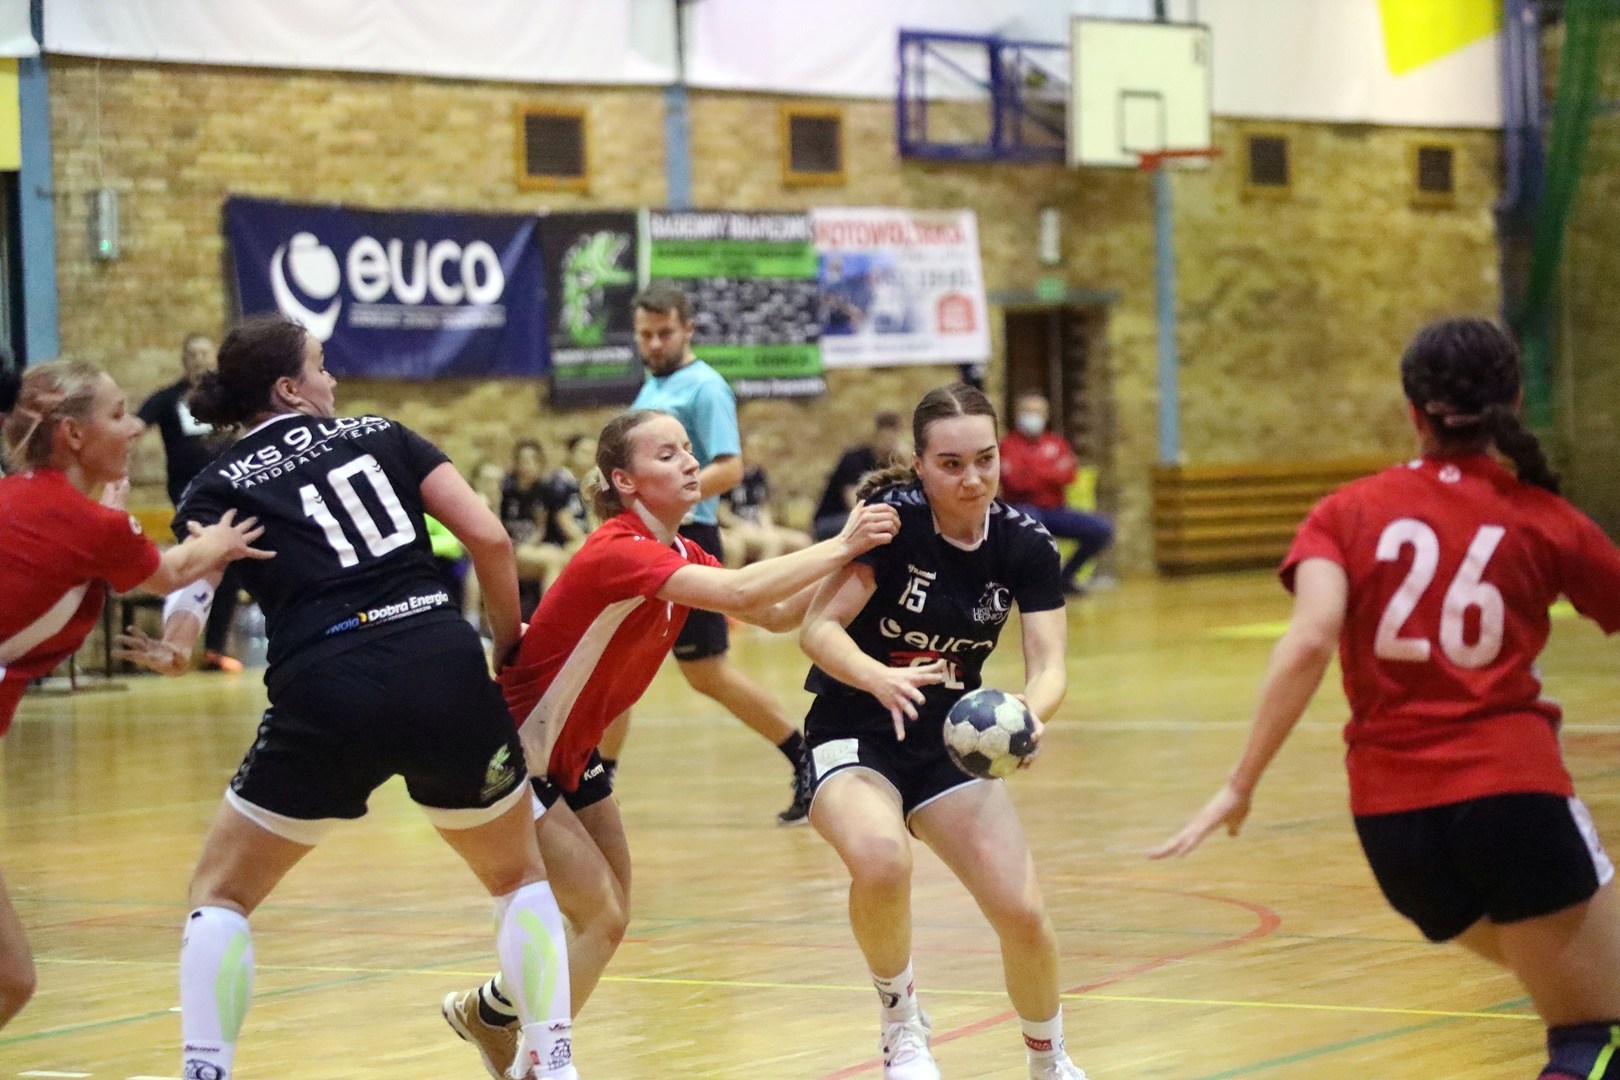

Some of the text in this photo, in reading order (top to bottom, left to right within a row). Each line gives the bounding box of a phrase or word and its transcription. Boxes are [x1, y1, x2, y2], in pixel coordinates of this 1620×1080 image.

[347, 236, 504, 304] euco
[218, 445, 283, 480] UKS
[283, 426, 313, 451] 9
[340, 421, 391, 440] TEAM
[299, 454, 417, 568] 10
[368, 601, 409, 622] Dobra
[409, 591, 449, 606] Energia
[898, 576, 930, 613] 15
[1374, 517, 1506, 669] 26
